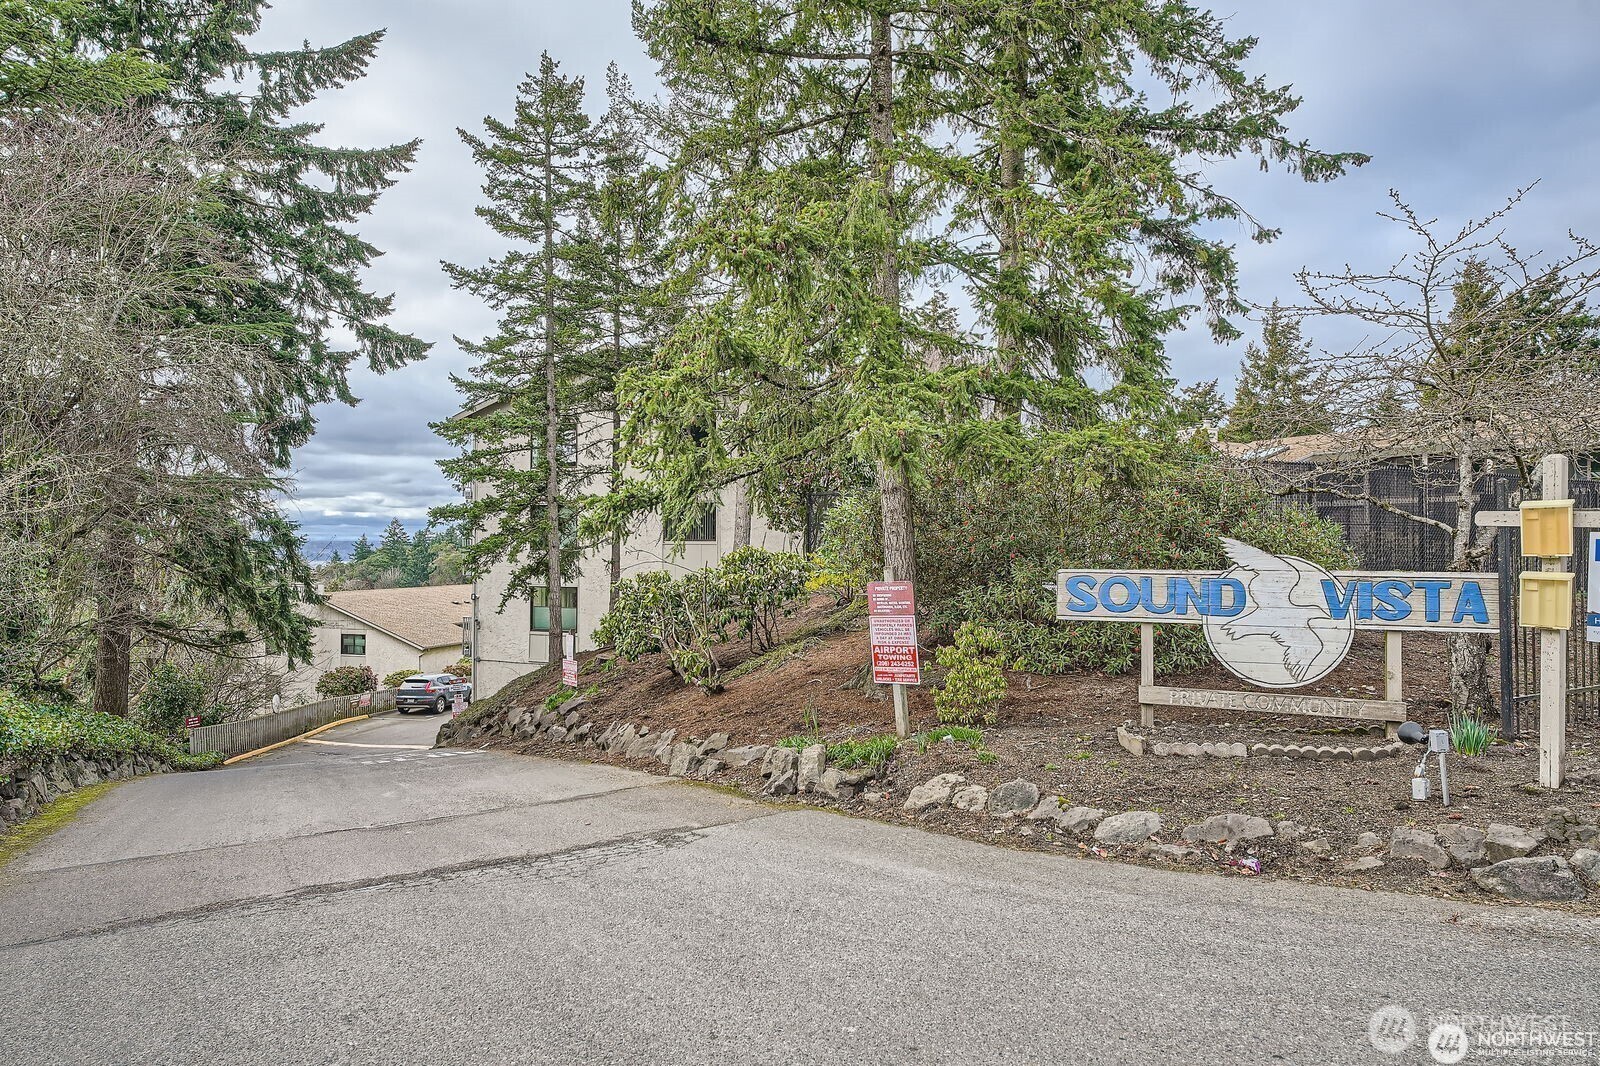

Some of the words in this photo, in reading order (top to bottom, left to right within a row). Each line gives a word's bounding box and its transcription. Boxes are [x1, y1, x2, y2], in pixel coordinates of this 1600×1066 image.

[1064, 575, 1248, 618] SOUND
[1320, 578, 1490, 625] VISTA
[874, 646, 915, 654] AIRPORT
[1168, 688, 1237, 709] PRIVATE
[1241, 692, 1367, 718] COMMUNITY
